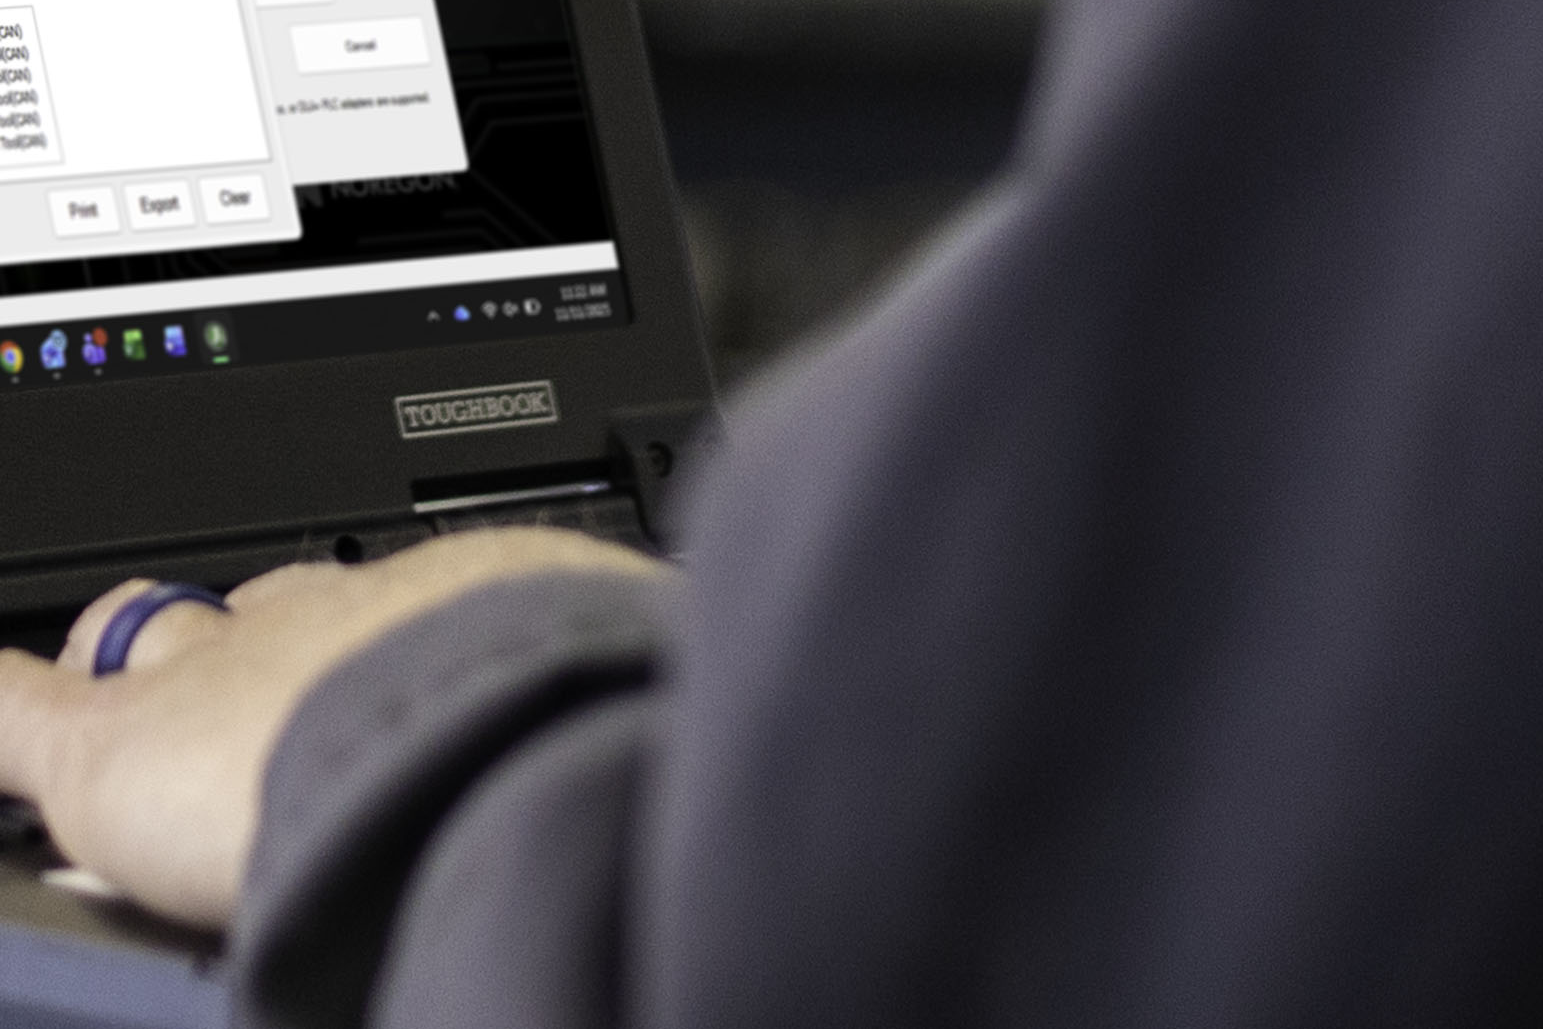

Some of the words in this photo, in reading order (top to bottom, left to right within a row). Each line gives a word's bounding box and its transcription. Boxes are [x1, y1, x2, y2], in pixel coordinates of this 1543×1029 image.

[139, 194, 180, 215] Export
[219, 188, 251, 207] Clear
[67, 201, 98, 220] Print
[404, 391, 547, 427] TOUGHBOOK
